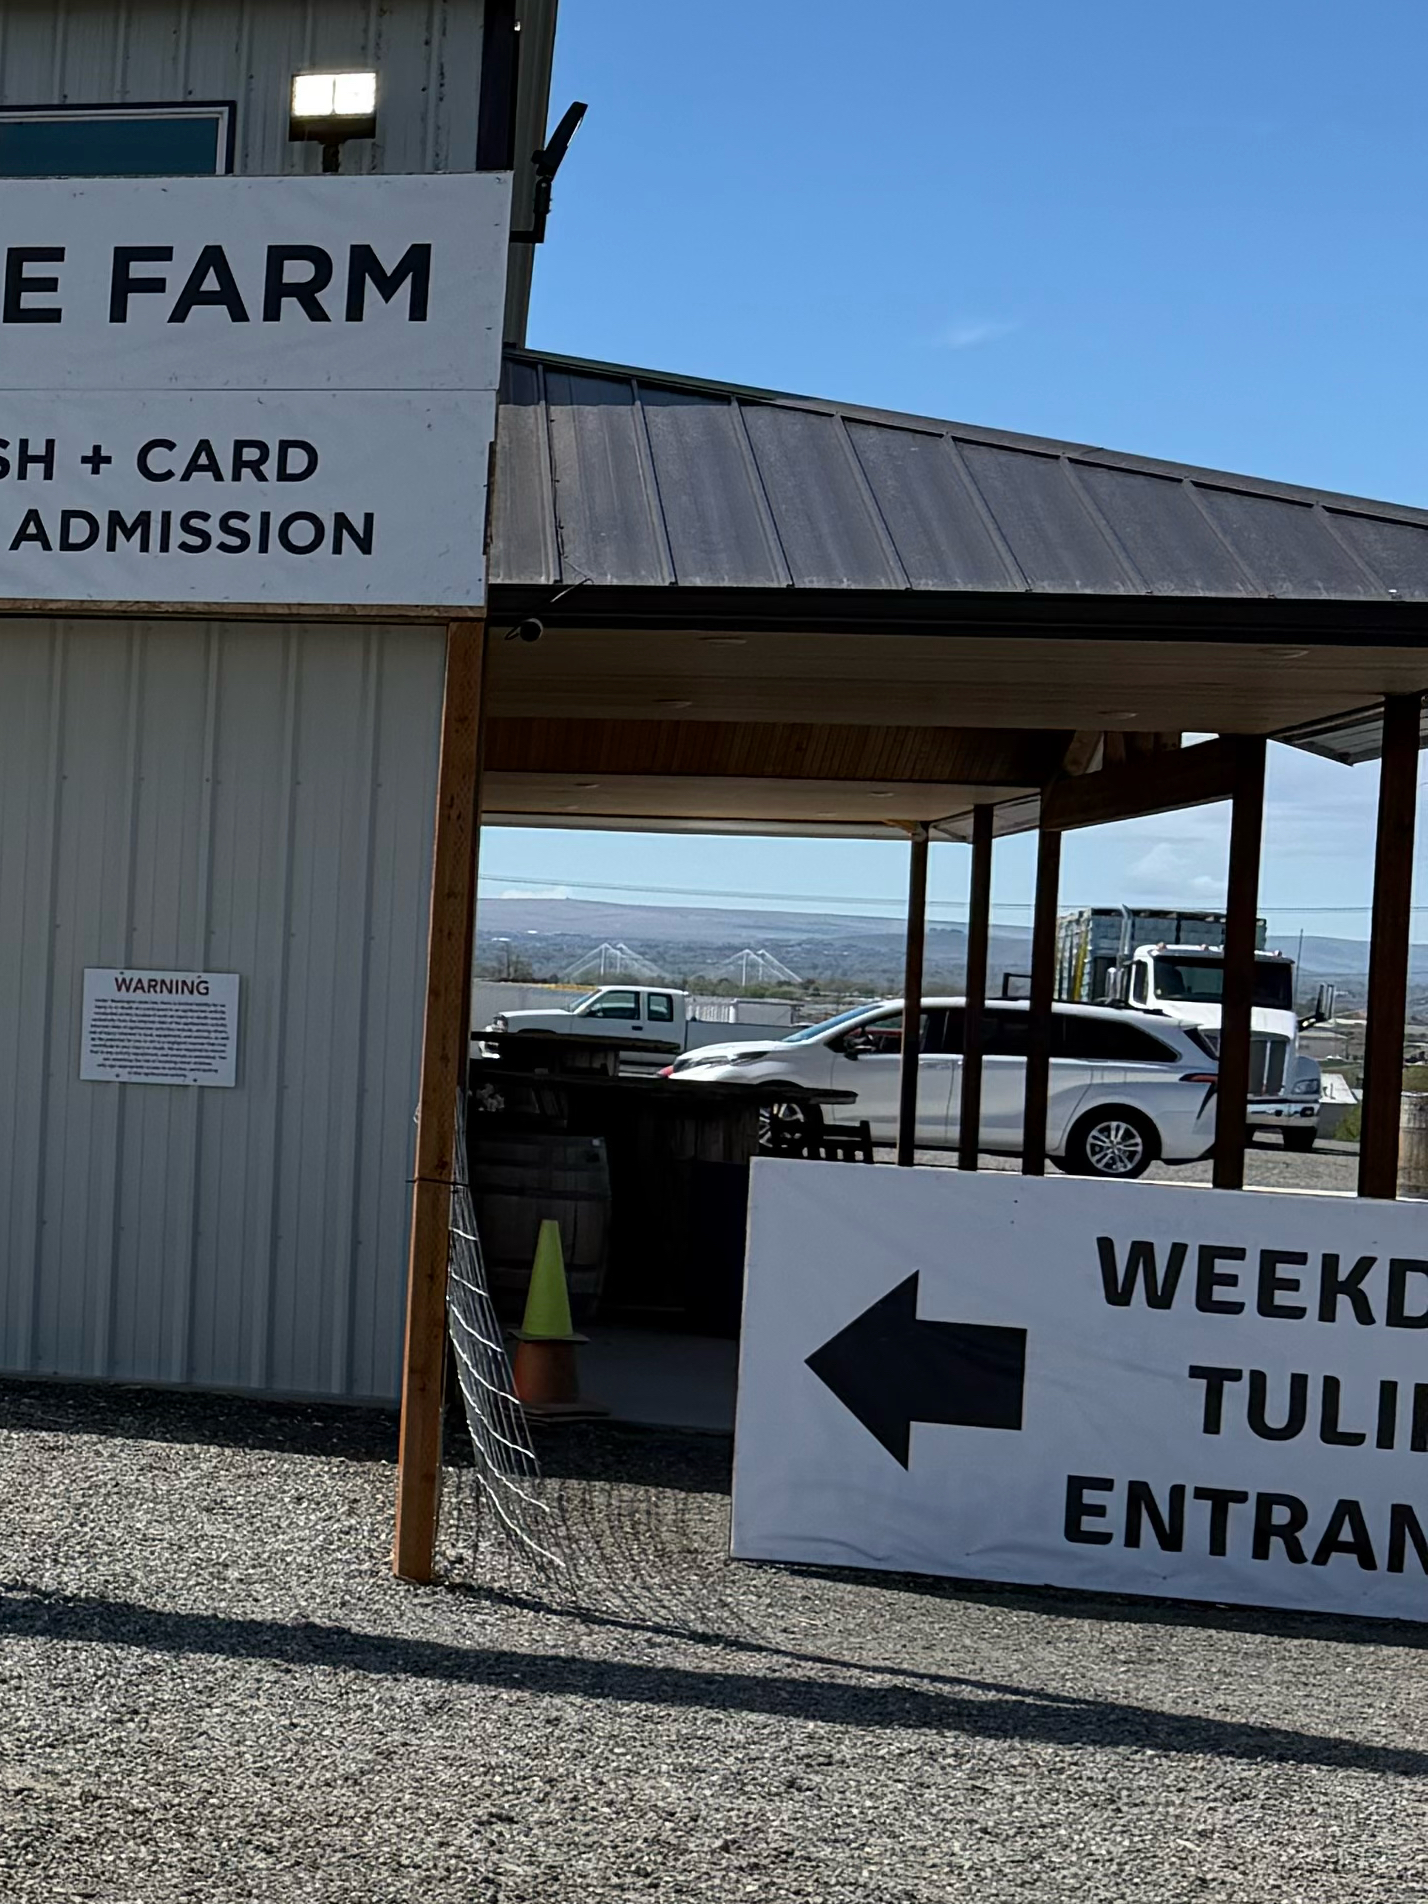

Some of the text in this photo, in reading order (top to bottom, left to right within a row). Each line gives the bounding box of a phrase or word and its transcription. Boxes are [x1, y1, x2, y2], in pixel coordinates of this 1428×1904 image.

[108, 243, 432, 324] FARM
[80, 444, 113, 476] +
[136, 438, 319, 483] CARD
[8, 508, 375, 556] ADMISSION
[114, 977, 210, 996] WARNING
[1096, 1236, 1428, 1330] WEEKD
[1063, 1474, 1428, 1576] ENTRAN
